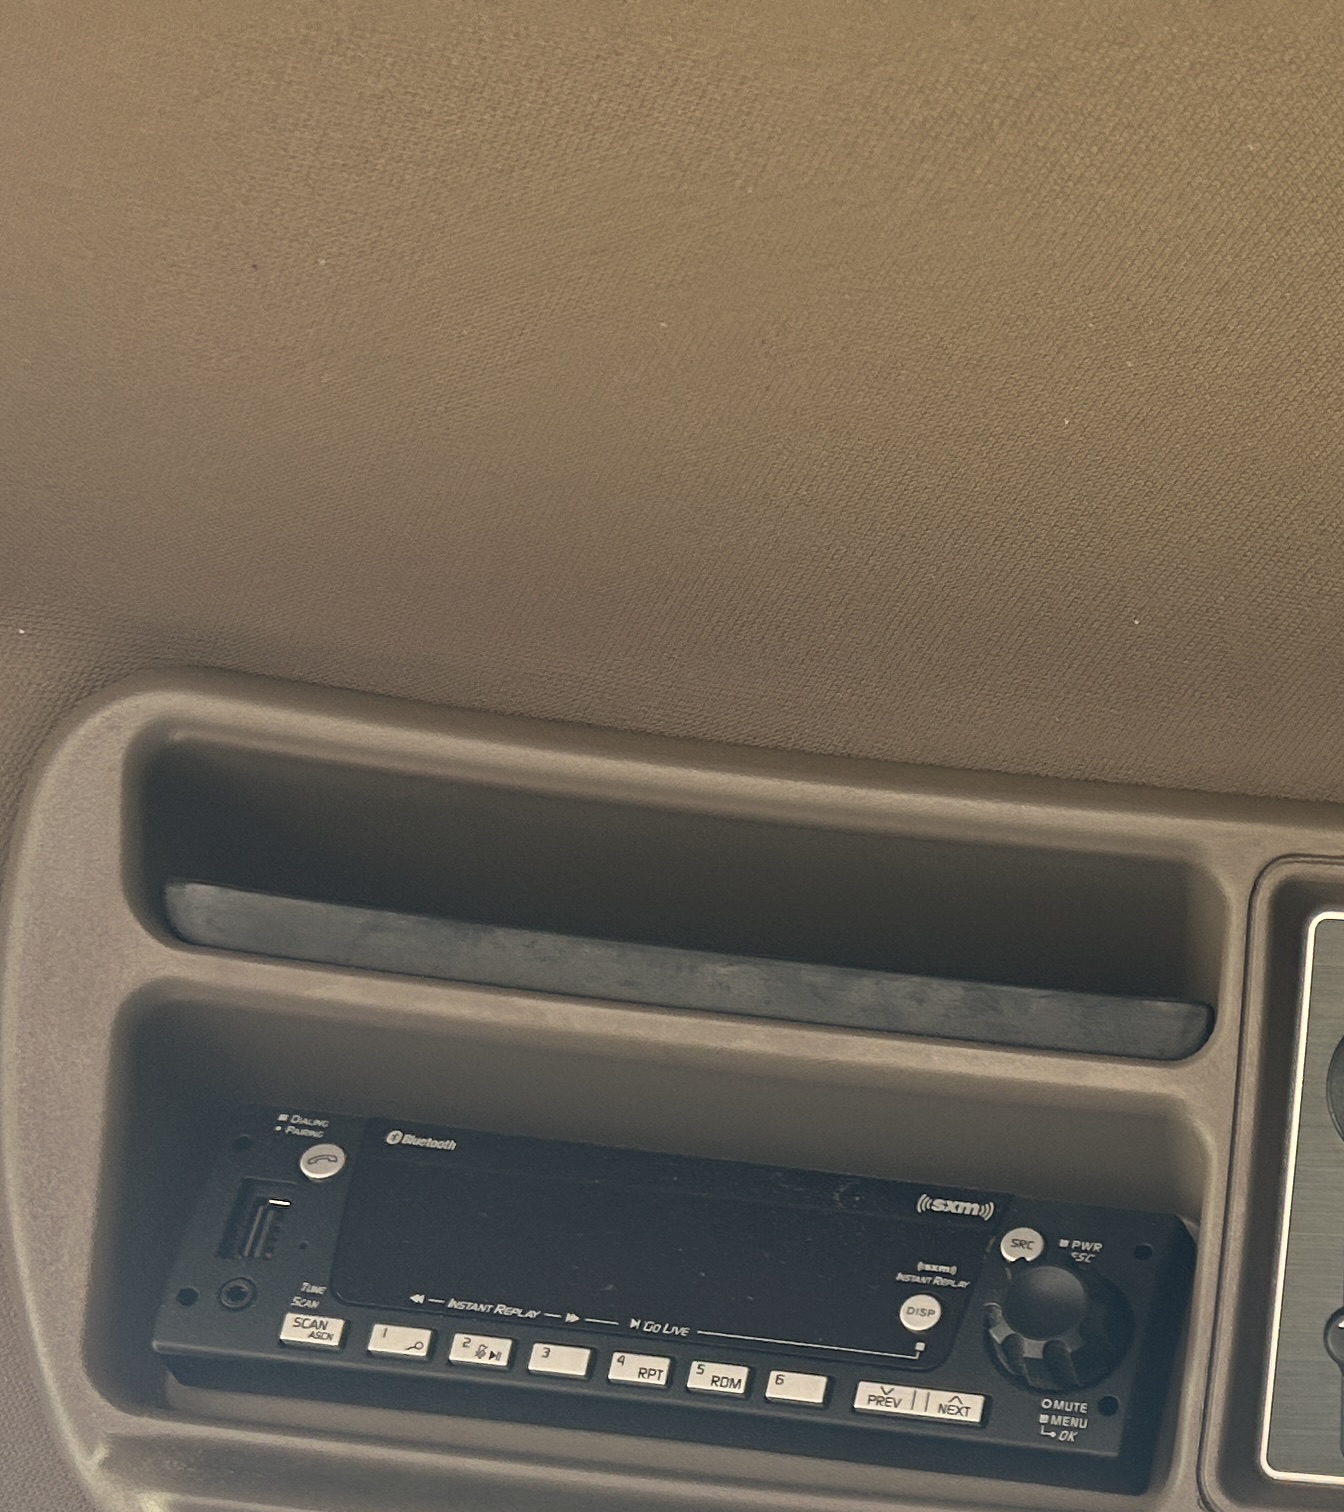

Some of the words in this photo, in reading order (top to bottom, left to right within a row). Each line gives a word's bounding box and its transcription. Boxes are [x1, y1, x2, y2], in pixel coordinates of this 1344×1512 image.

[401, 1134, 457, 1150] Bluetooth
[1010, 1238, 1036, 1250] SRC
[1071, 1240, 1103, 1253] PWR
[300, 1282, 327, 1295] TUNE
[290, 1297, 320, 1309] SCAN
[447, 1298, 491, 1313] INSTANT
[493, 1304, 541, 1319] REPLAY
[906, 1306, 936, 1317] DISP
[292, 1316, 329, 1331] SCAN
[383, 1328, 388, 1338] 1
[462, 1337, 471, 1348] 2
[541, 1347, 551, 1359] 3
[616, 1354, 626, 1366] 4
[638, 1367, 664, 1382] RPT
[695, 1364, 705, 1375] 5
[711, 1376, 742, 1391] RDM
[775, 1374, 785, 1386] 6
[867, 1395, 903, 1408] PREV
[1053, 1400, 1089, 1414] MUTE
[937, 1404, 972, 1417] NEXT
[1050, 1415, 1089, 1429] MENU
[1058, 1430, 1078, 1442] OK
